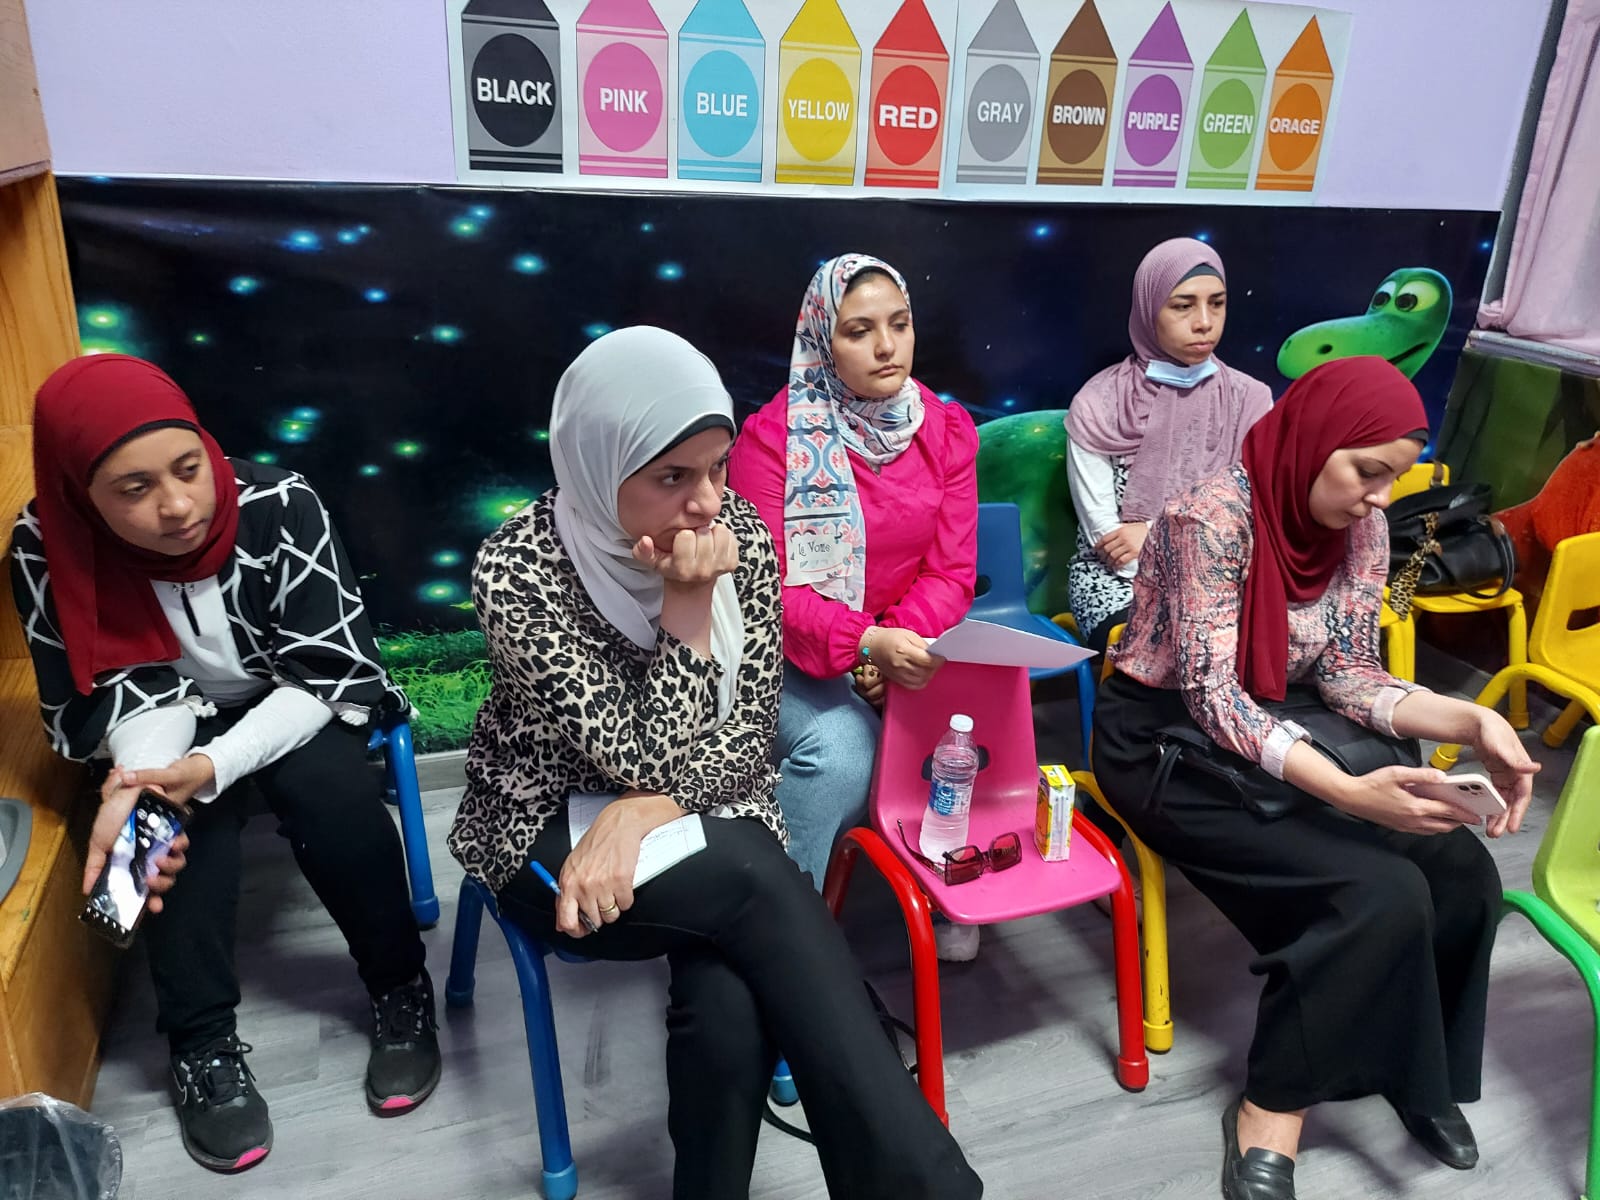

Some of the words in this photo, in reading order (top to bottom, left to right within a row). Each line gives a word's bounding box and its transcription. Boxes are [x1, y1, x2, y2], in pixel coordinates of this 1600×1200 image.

[476, 76, 553, 108] BLACK
[599, 86, 649, 115] PINK
[696, 91, 749, 119] BLUE
[788, 98, 850, 122] YELLOW
[878, 104, 938, 130] RED
[976, 100, 1024, 124] GRAY
[1052, 105, 1106, 127] BROWN
[1127, 111, 1180, 132] PURPLE
[1203, 112, 1253, 135] GREEN
[1269, 117, 1320, 136] ORAGE
